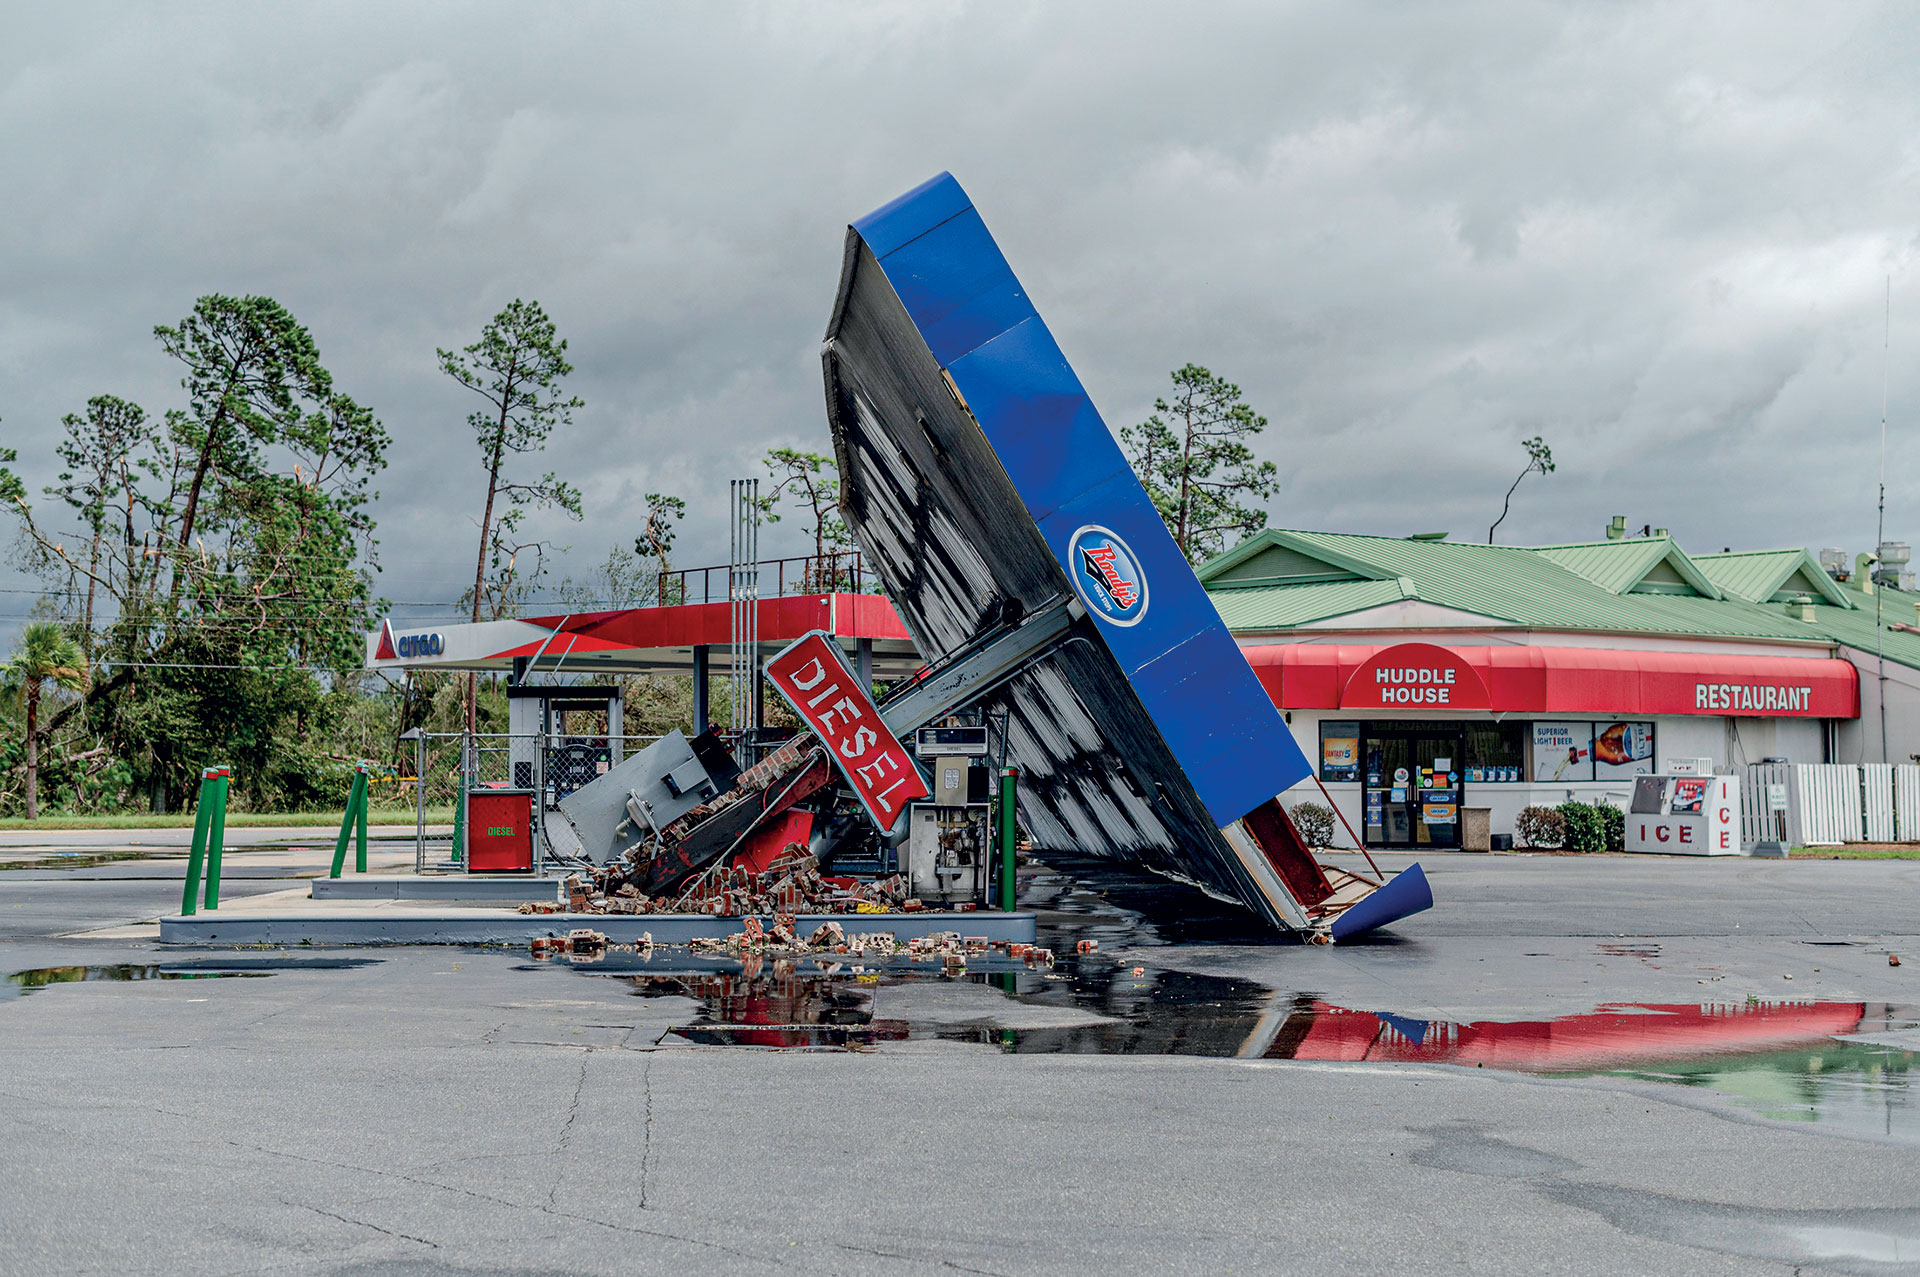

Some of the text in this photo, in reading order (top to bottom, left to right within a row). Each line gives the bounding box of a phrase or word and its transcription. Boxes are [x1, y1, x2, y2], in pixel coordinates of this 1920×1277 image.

[1086, 543, 1138, 607] Roady's
[398, 633, 441, 658] CITGO
[1376, 668, 1456, 684] HUDDLE
[1382, 687, 1450, 703] HOUSE
[1695, 683, 1811, 711] RESTAURANT
[789, 656, 906, 813] DIESEL
[1537, 727, 1569, 736] SUPERIOR
[1533, 737, 1573, 745] LIGHT BEER
[1326, 749, 1351, 758] FANTASY 5
[1719, 782, 1730, 849] ICE
[487, 826, 516, 836] DIESEL
[1640, 824, 1693, 844] ICE
